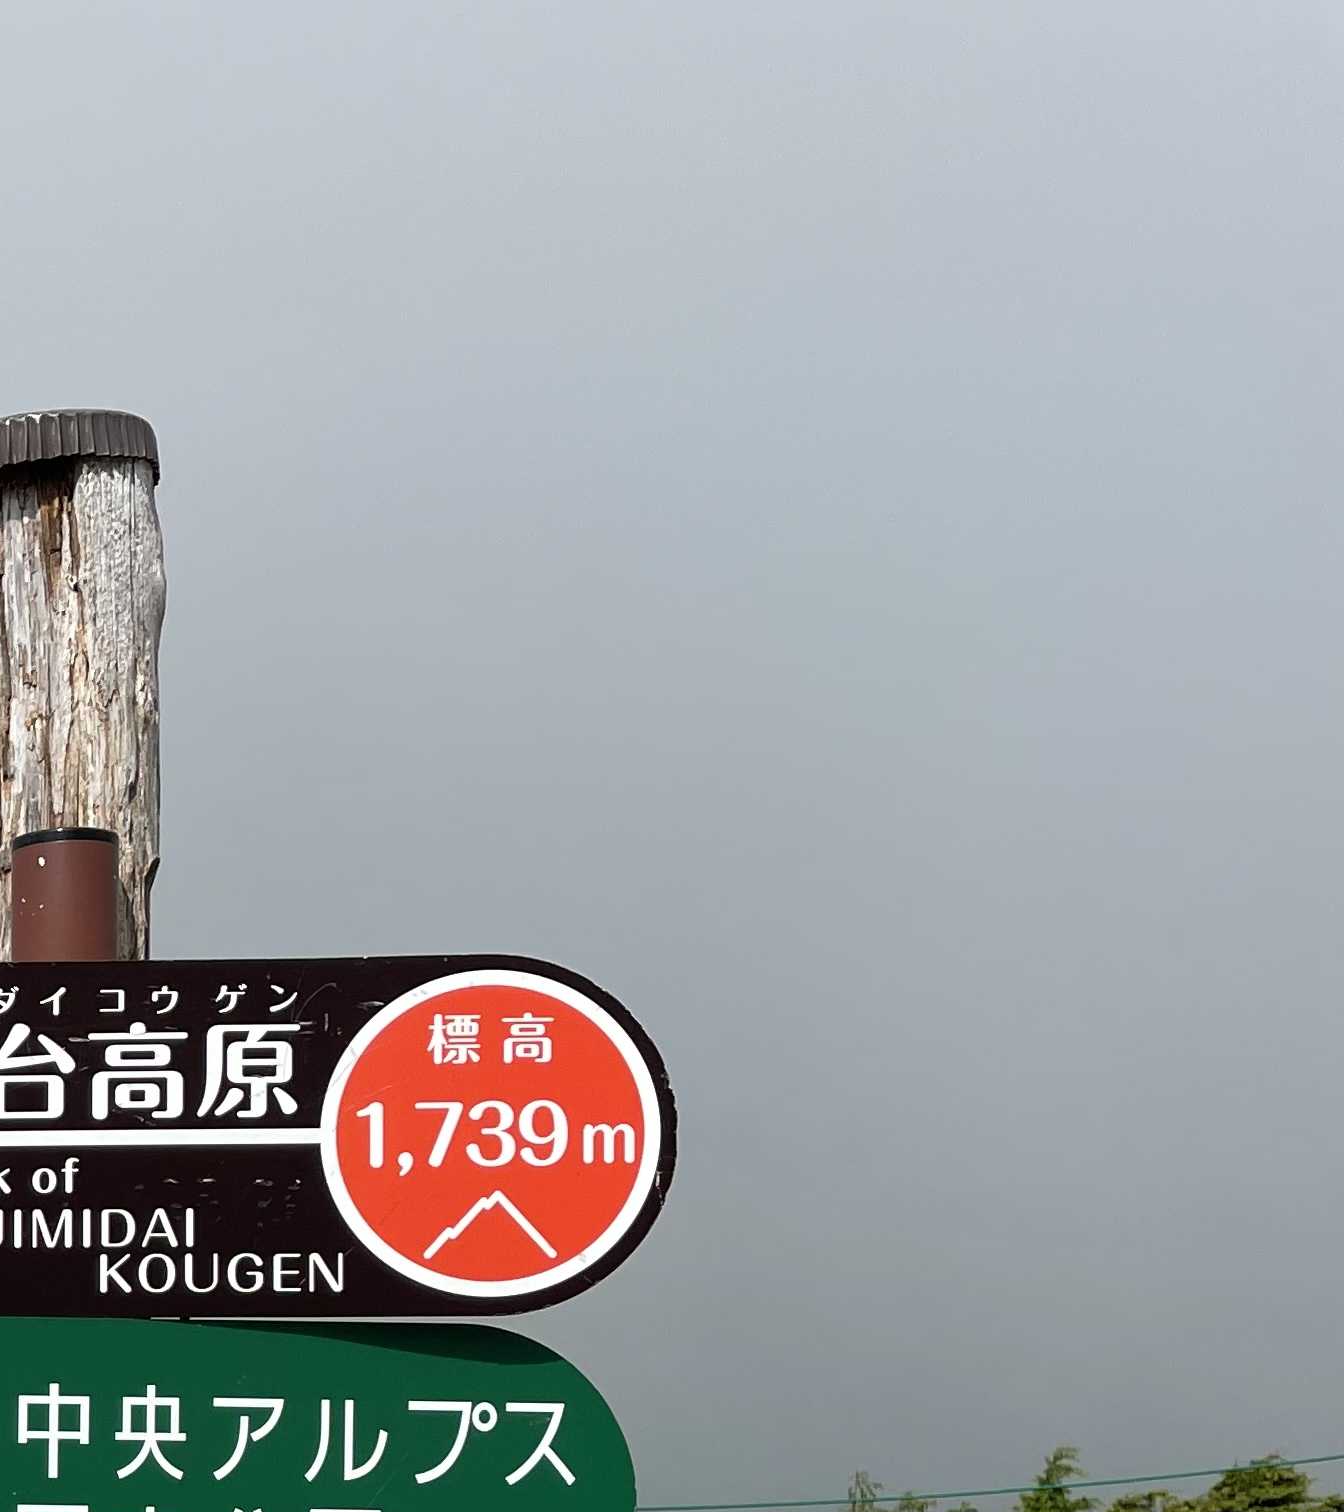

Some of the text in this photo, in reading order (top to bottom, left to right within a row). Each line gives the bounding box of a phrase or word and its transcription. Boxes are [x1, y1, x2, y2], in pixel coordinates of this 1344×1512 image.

[427, 1013, 553, 1064] 標高
[32, 1158, 79, 1193] of
[100, 1253, 343, 1293] KOUGEN
[18, 1383, 575, 1485] 中央アルプス
